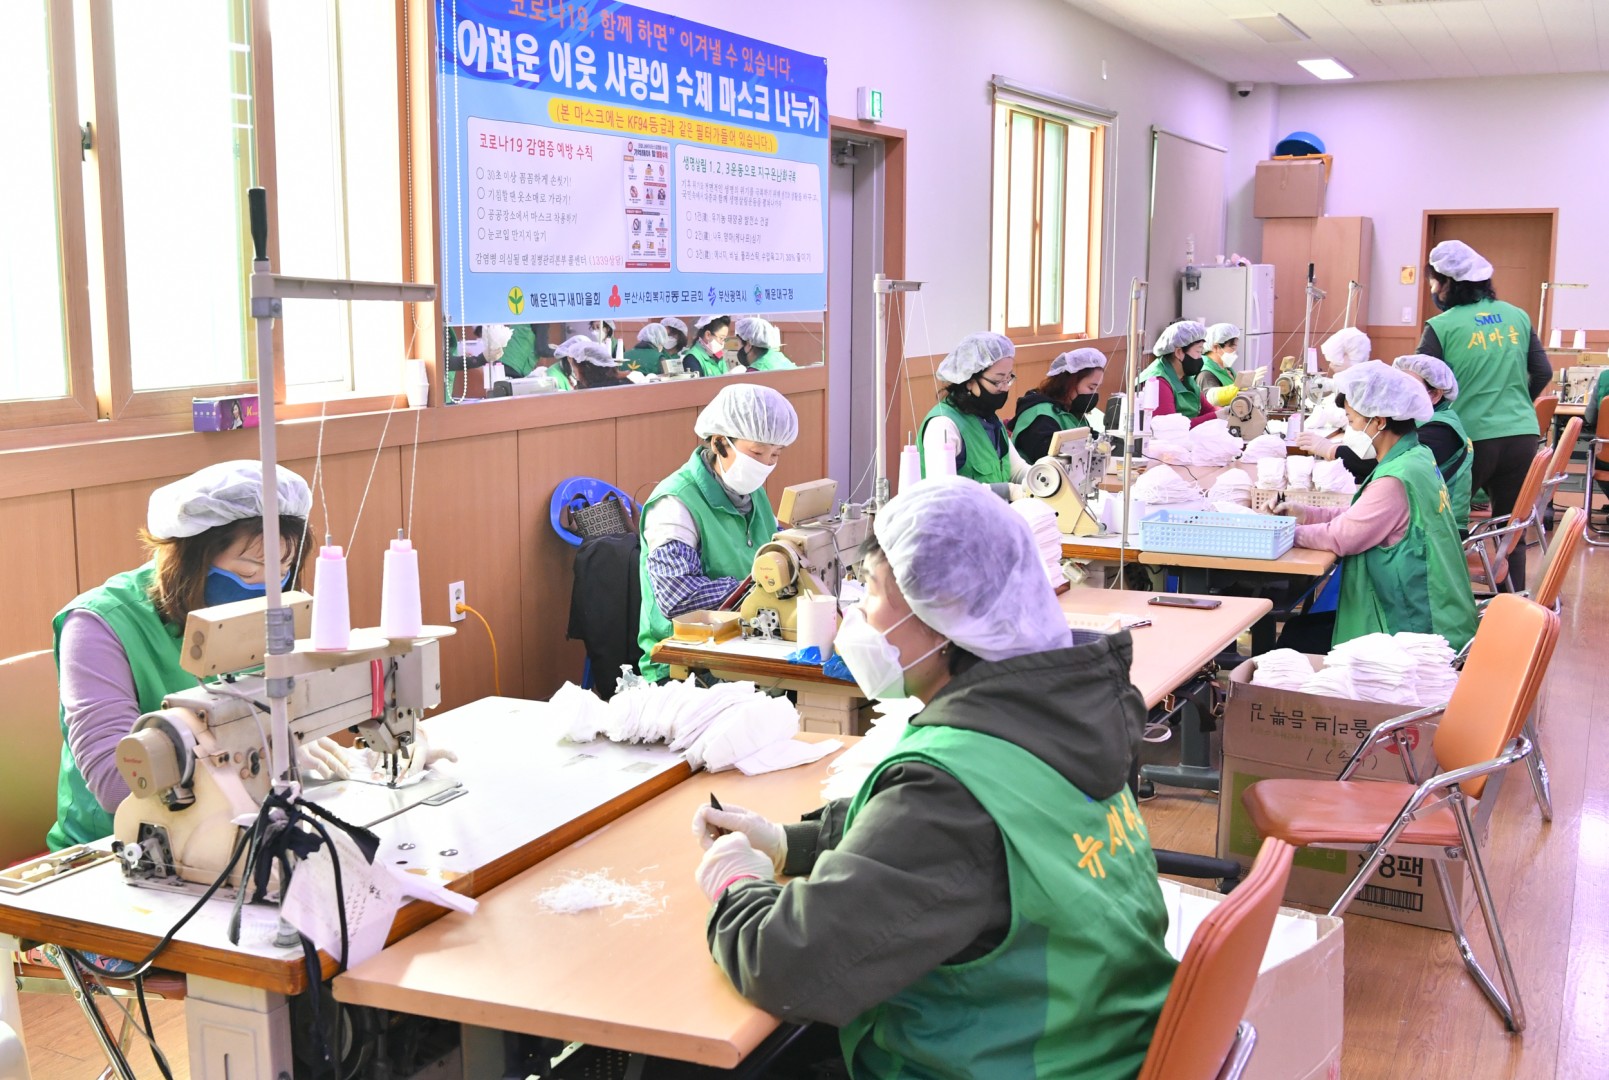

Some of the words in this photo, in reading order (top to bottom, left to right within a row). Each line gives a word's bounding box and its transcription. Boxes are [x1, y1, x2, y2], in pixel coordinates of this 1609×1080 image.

[680, 31, 722, 66] 이겨낼
[725, 43, 738, 68] 수
[742, 47, 795, 83] 있습니다.
[457, 19, 540, 83] 어려운
[549, 39, 597, 93] 이웃
[604, 51, 670, 104] 사랑의
[676, 66, 713, 113] 수제
[719, 75, 770, 122] 마스크
[774, 88, 820, 132] 나누기
[556, 103, 570, 122] (본
[574, 105, 625, 129] 마스크에는
[679, 120, 694, 139] 같은
[739, 131, 773, 152] 있습니다.)
[479, 133, 523, 153] 코로나19
[526, 138, 555, 158] 감염증
[556, 142, 573, 160] 예방
[576, 145, 593, 162] 수칙
[486, 169, 502, 181] 30초
[503, 169, 517, 184] 이상
[530, 210, 552, 223] 마스크
[530, 291, 601, 308] 해운대구새마을회
[718, 289, 747, 303] 부산광역시
[764, 288, 794, 301] 해운대구청
[1474, 313, 1503, 326] SMU
[1468, 325, 1520, 350] 새마을
